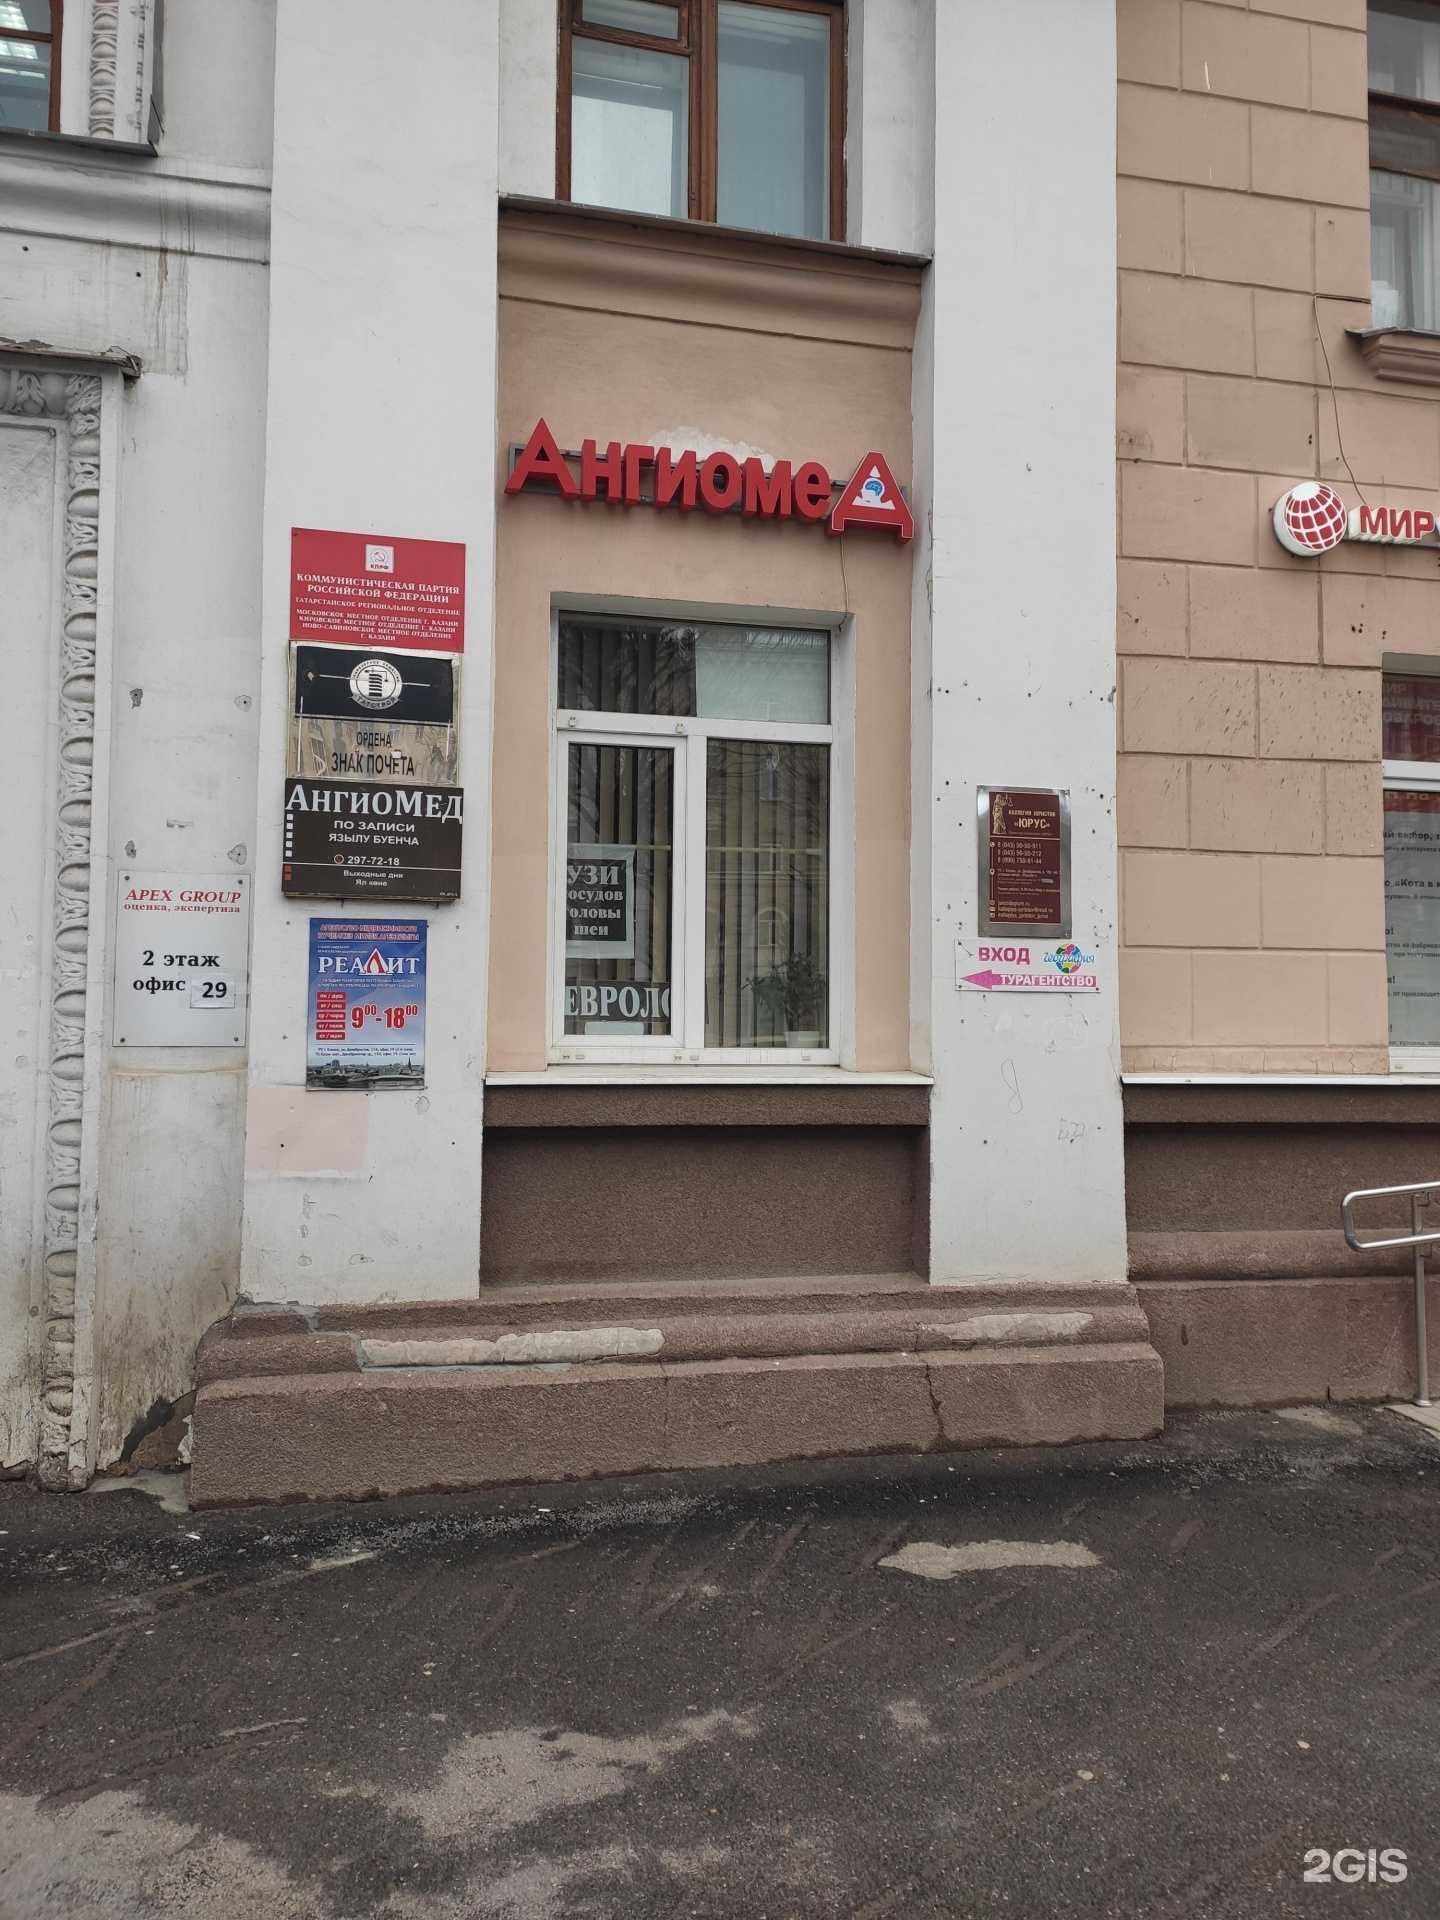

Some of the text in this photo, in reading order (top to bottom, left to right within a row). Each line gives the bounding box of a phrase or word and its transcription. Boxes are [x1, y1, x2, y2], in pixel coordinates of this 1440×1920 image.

[1360, 505, 1435, 539] МИР
[296, 573, 459, 595] КОММУНИСТИЧЕСКАЯ ПАРТИЯ
[307, 584, 449, 604] РОССИЙСКОЙ ФЕДЕРАЦИИ
[296, 597, 461, 616] ТАТАРСТАНСКОЕ РЕГИОНАЛЬНОЕ ОТДЕЛЕНИЕ
[296, 608, 344, 618] МОСКОВСКОЕ
[347, 613, 379, 621] МЕСТНОЕ
[381, 615, 421, 624] ОТДЕЛЕНИЕ
[432, 619, 459, 627] КАЗАНИ
[299, 616, 341, 624] КИРОВСКОЕ
[343, 620, 376, 628] МЕСТНОЕ
[378, 622, 419, 630] ОТДЕЛЕНИЕ
[302, 623, 452, 639] НОВО-САВИНОВСКОЕ МЕСТНОЕ ОТДЕЛЕНИЕ
[356, 731, 392, 748] ОРДЕНА
[331, 752, 363, 773] ЗНАК
[334, 820, 415, 833] ПО ЗАПИСИ
[328, 833, 419, 846] ЯЗЫЛУ БУЕНЧА
[347, 856, 400, 866] 297-72-18
[343, 869, 387, 879] Выходные
[567, 865, 620, 885] УЗИ
[125, 889, 241, 903] APEX GROUP
[124, 904, 240, 914] оценка, экспертиза
[567, 907, 621, 919] оловы
[142, 950, 220, 967] 2 этаж
[318, 948, 420, 976] РЕАЛИТ
[978, 947, 1030, 965] ВХОД
[133, 977, 227, 998] офис 29
[1000, 975, 1094, 987] ТУРАГЕНТСТВО
